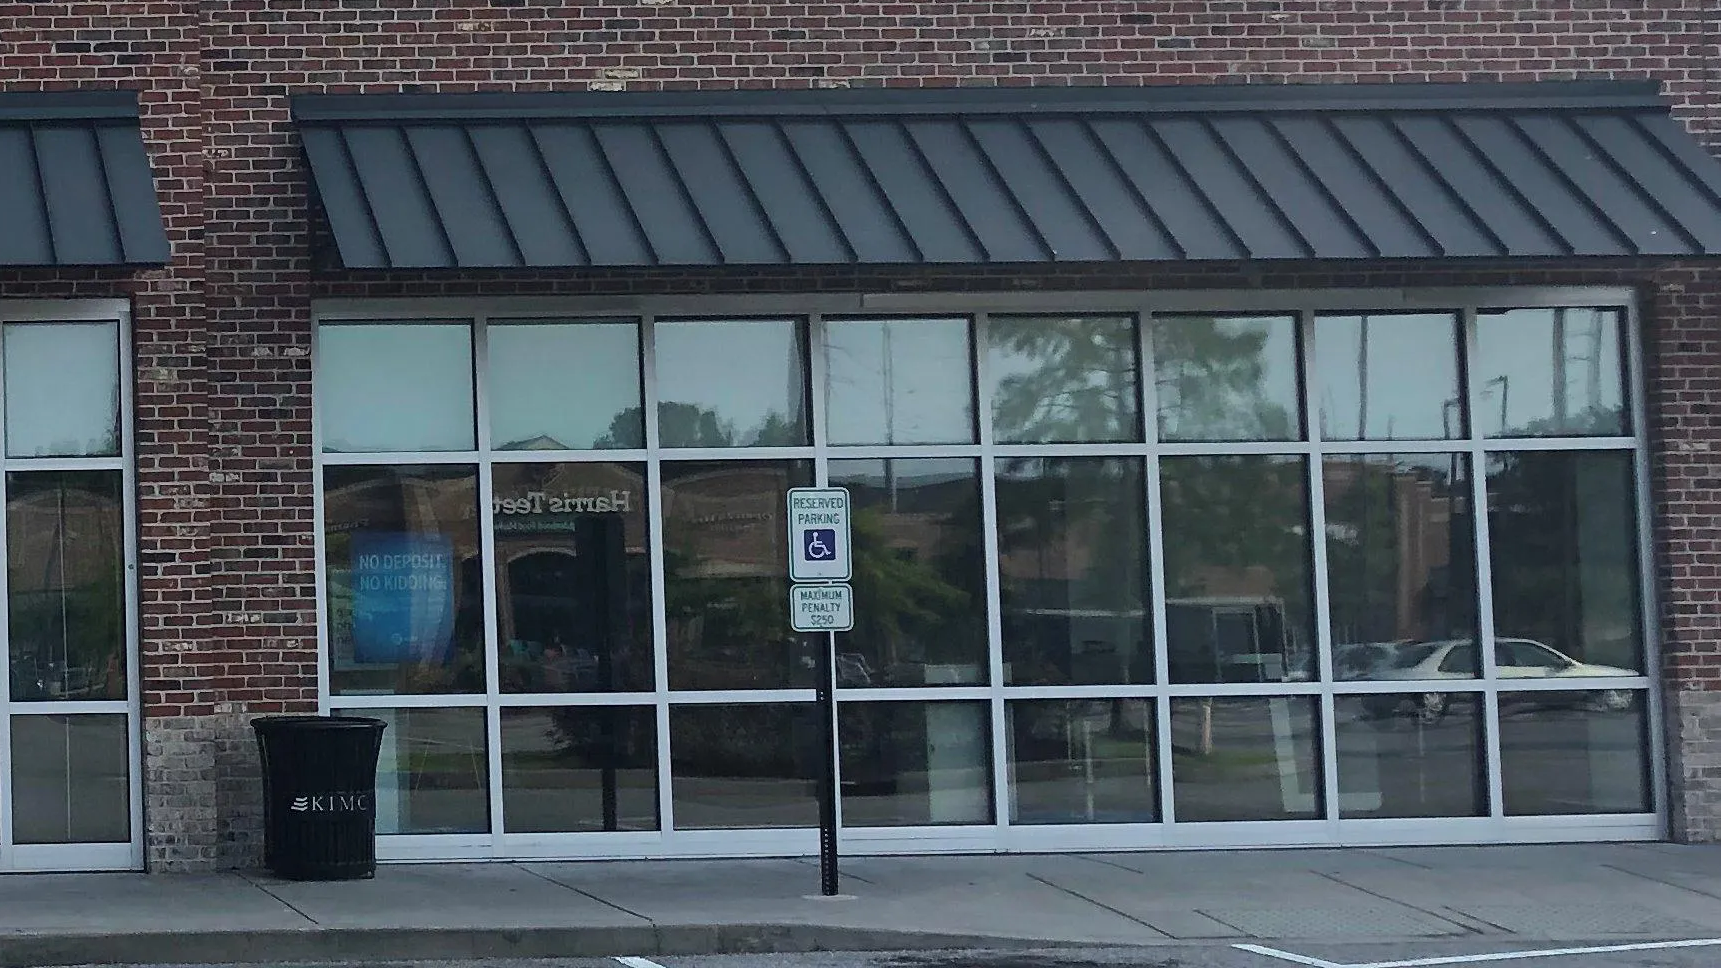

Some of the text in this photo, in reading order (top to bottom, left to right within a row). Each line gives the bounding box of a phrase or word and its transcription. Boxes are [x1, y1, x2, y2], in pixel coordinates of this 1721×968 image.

[793, 497, 844, 509] RESERVED
[798, 512, 840, 525] PARKING
[359, 553, 380, 570] NO
[359, 575, 381, 592] NO
[800, 590, 842, 602] MAXIMUM
[801, 602, 841, 613] PENALTY
[810, 614, 835, 626] $250
